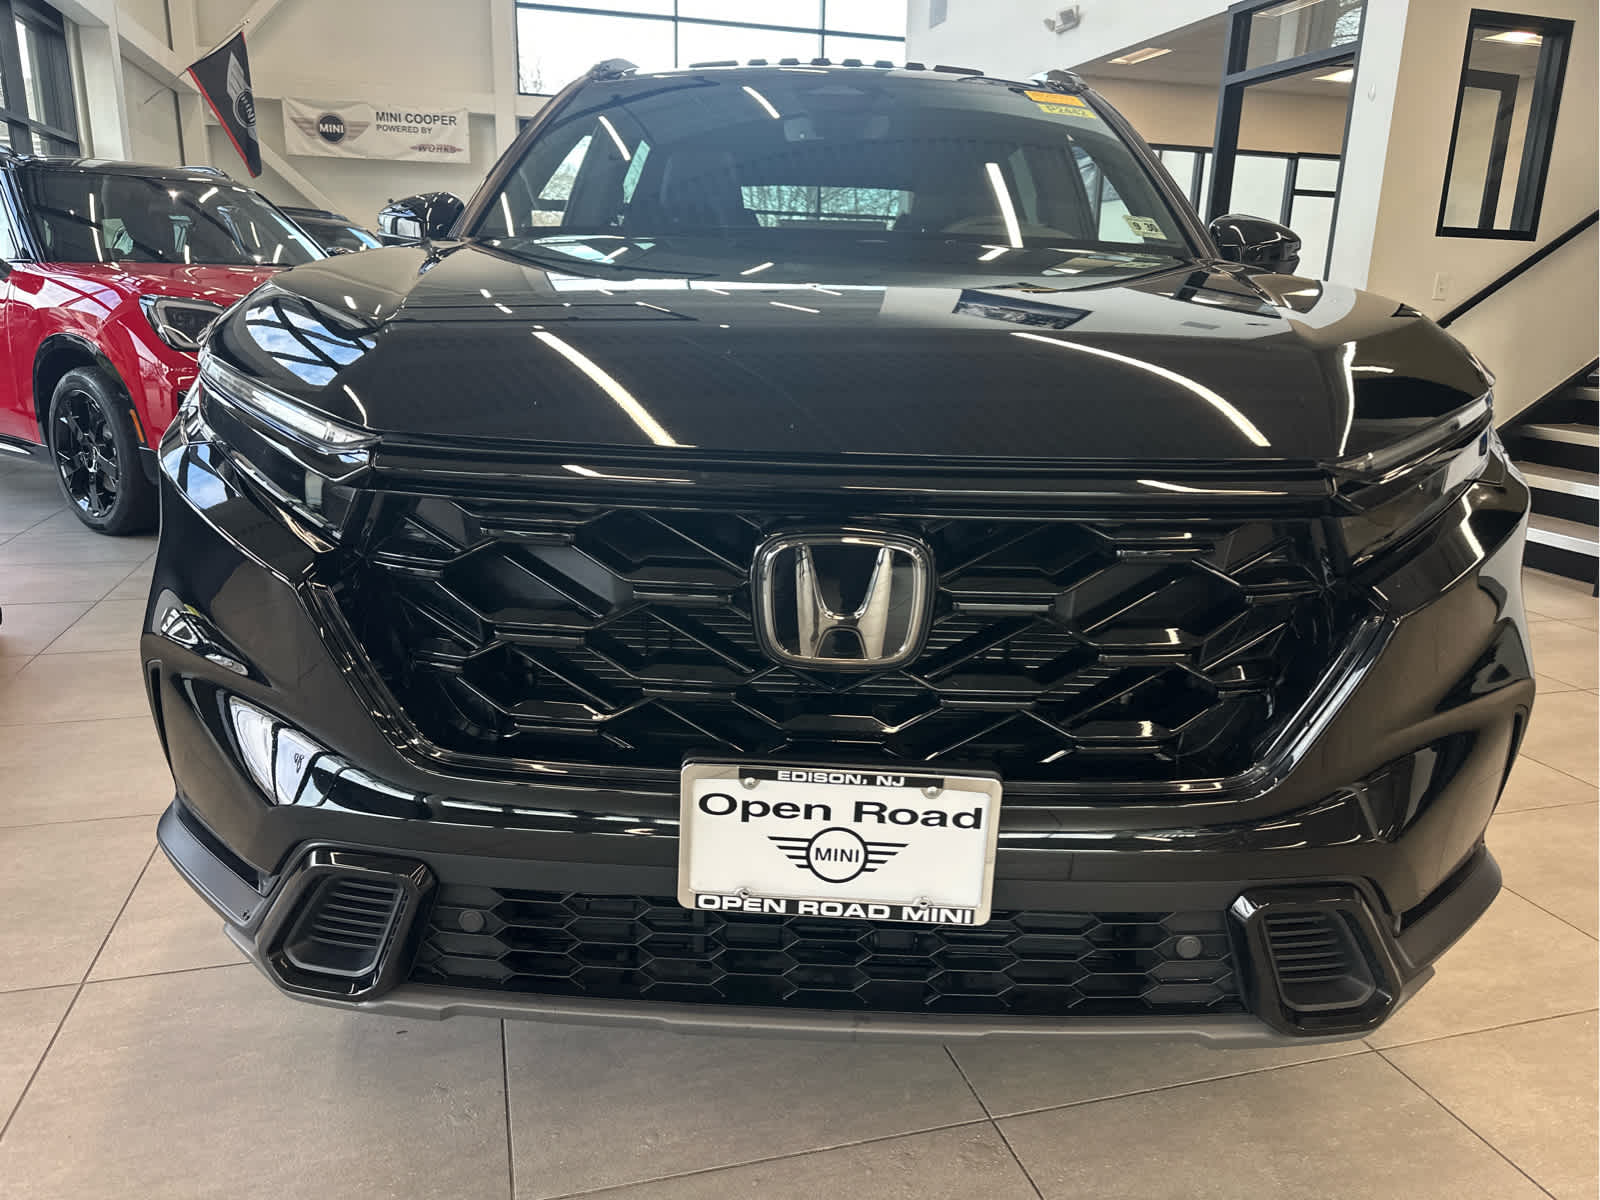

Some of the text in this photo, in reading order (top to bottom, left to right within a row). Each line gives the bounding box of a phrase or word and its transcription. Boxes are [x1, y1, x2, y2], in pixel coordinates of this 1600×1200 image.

[376, 111, 457, 126] MINI COOPER
[319, 122, 344, 134] MINI
[376, 125, 420, 134] POWERED
[777, 770, 905, 787] EDISON, NJ
[698, 792, 983, 830] Open Road
[814, 846, 860, 863] MINI
[697, 894, 974, 925] OPEN ROAD MINI
